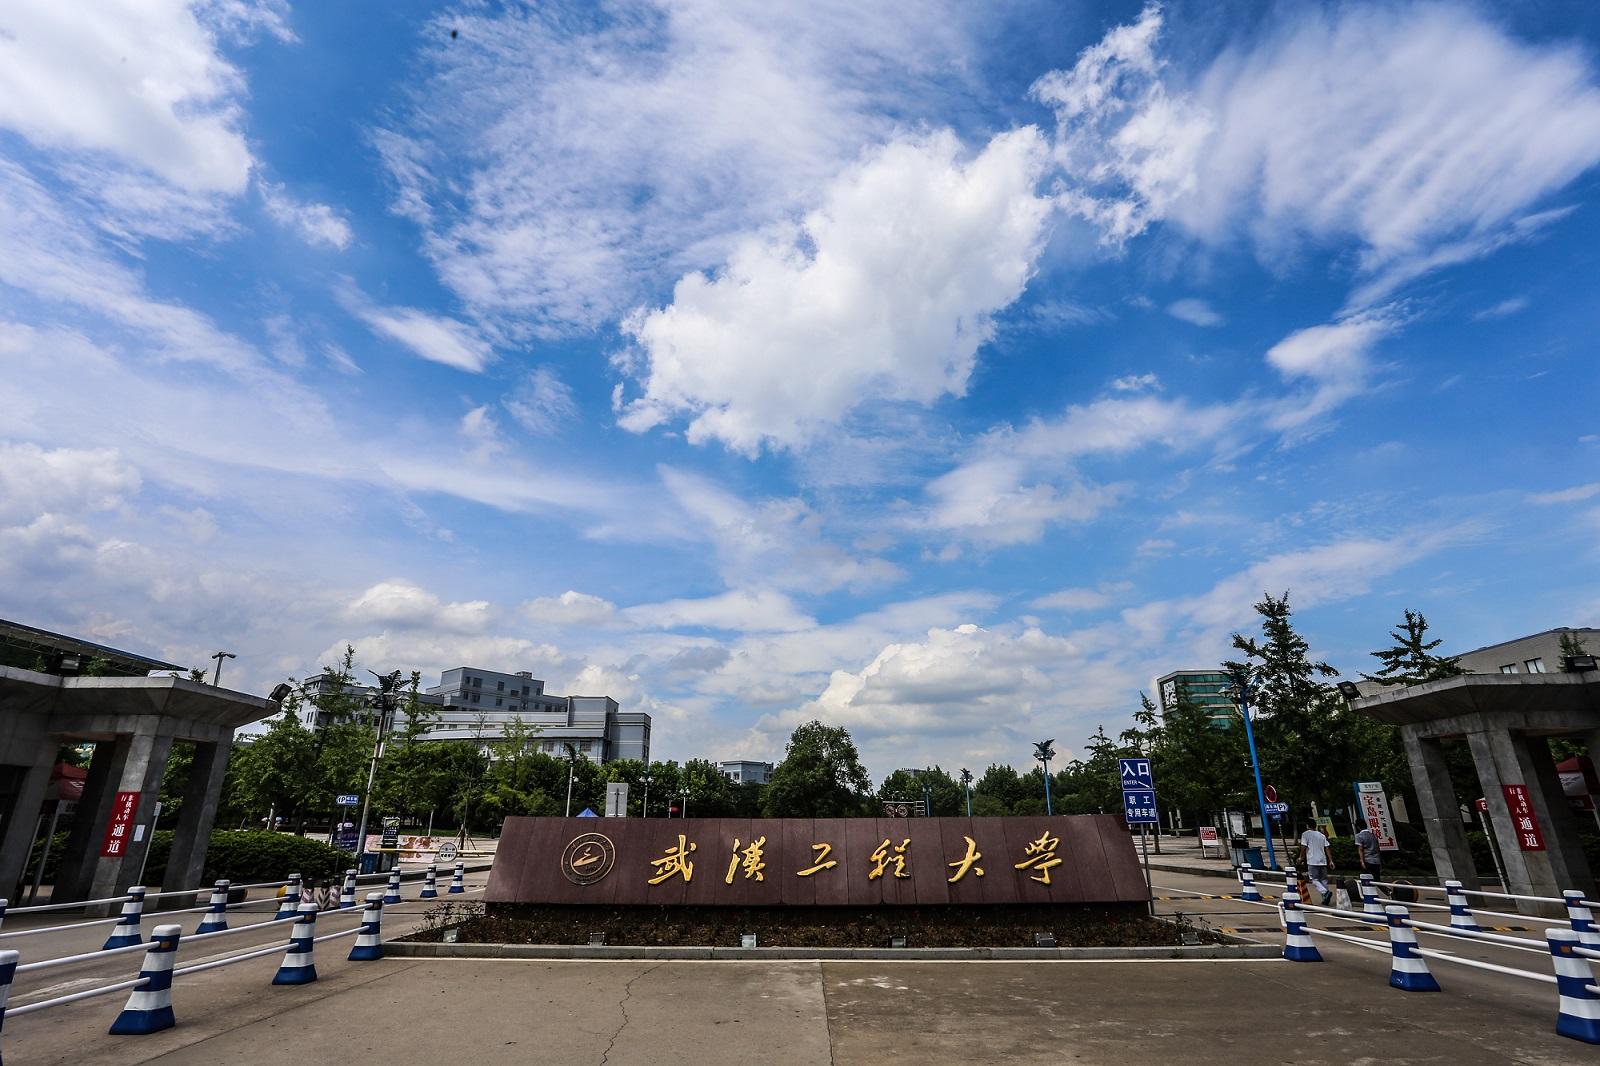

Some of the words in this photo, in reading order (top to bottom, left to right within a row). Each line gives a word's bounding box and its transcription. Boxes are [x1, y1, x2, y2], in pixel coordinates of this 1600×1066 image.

[1123, 762, 1149, 776] 入口
[1129, 796, 1150, 804] 职工
[1127, 808, 1155, 817] 专用车道
[1364, 795, 1382, 839] 宝岛眼镜
[107, 823, 126, 853] 通道
[1518, 817, 1539, 847] 通道
